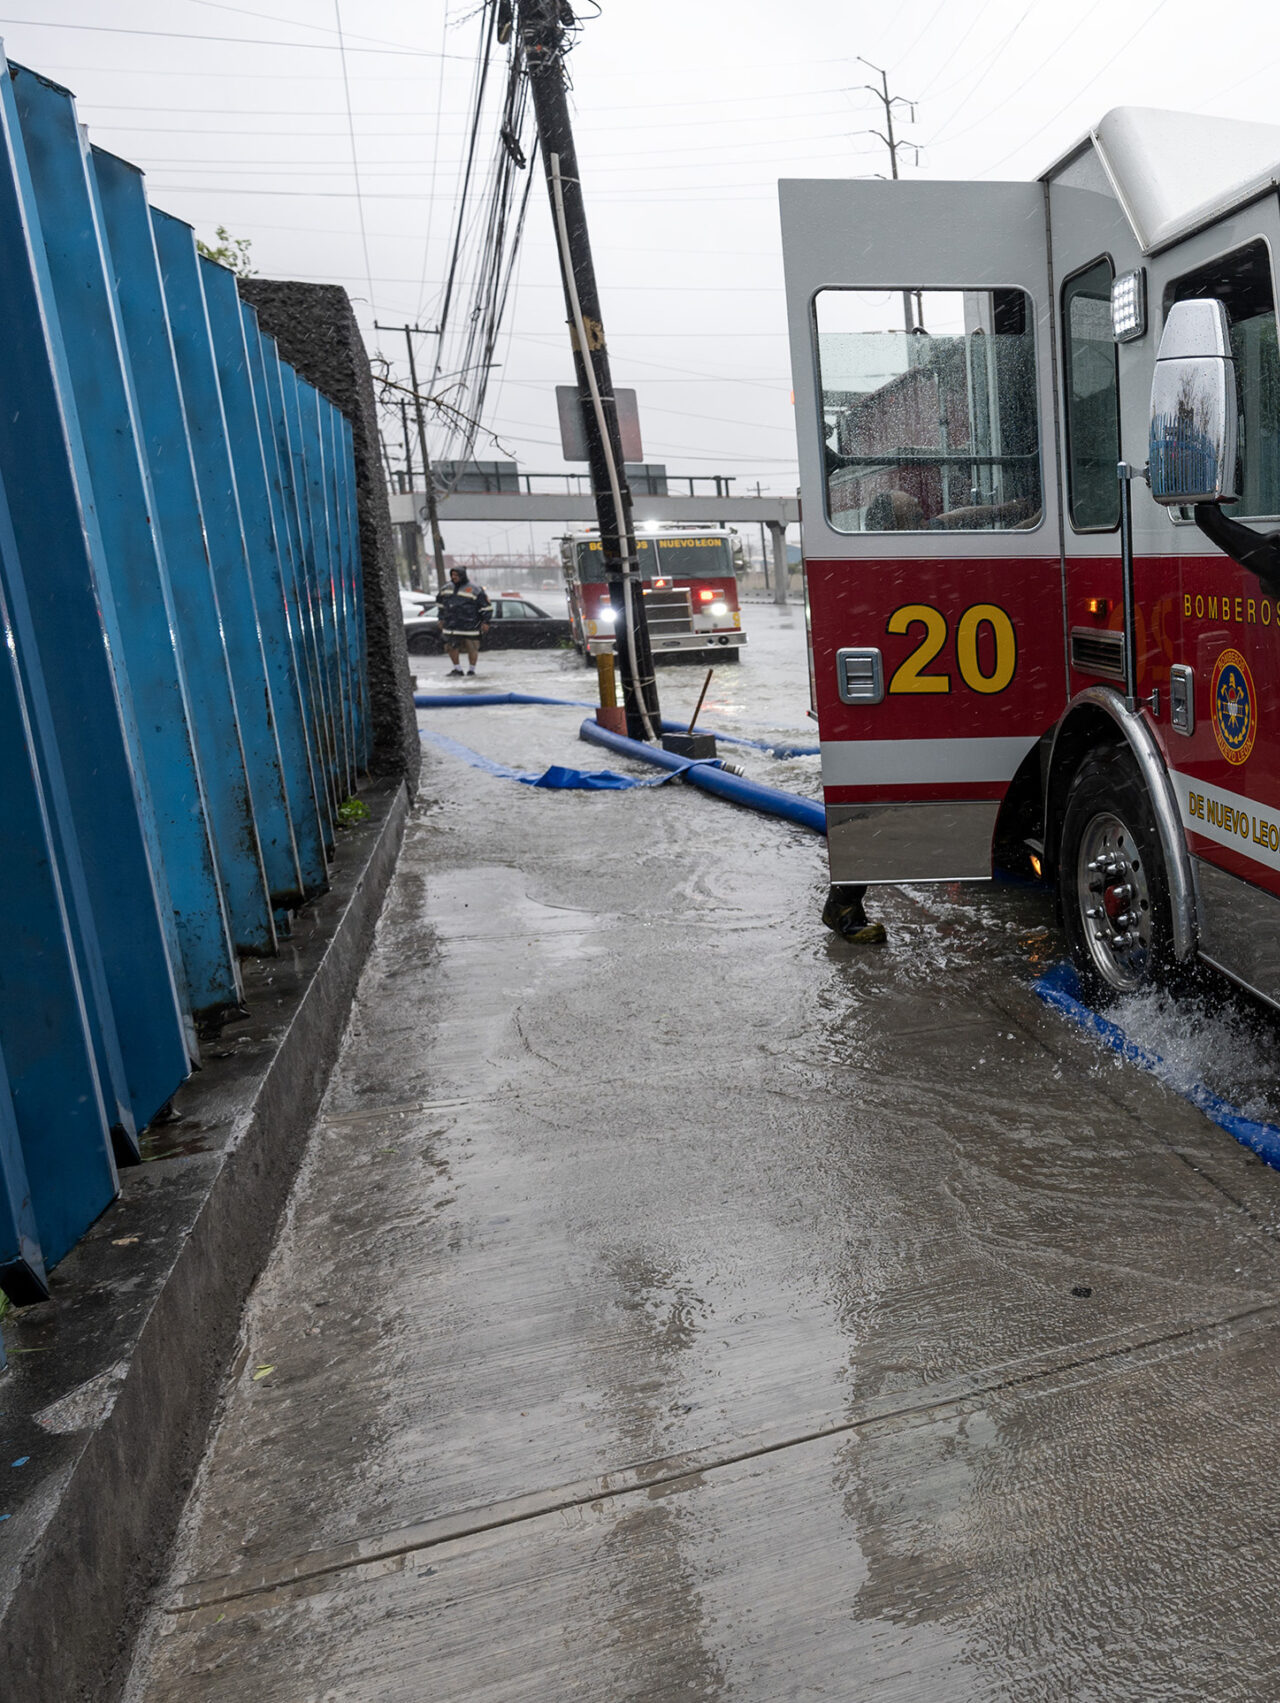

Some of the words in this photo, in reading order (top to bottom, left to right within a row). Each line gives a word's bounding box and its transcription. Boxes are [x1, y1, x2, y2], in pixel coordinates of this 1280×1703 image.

[659, 540, 694, 548] NUEVO
[695, 538, 722, 547] LEON
[886, 603, 1018, 695] 20
[1237, 737, 1252, 762] LEON
[1188, 791, 1205, 820] DE
[1206, 798, 1249, 839] NUEVO
